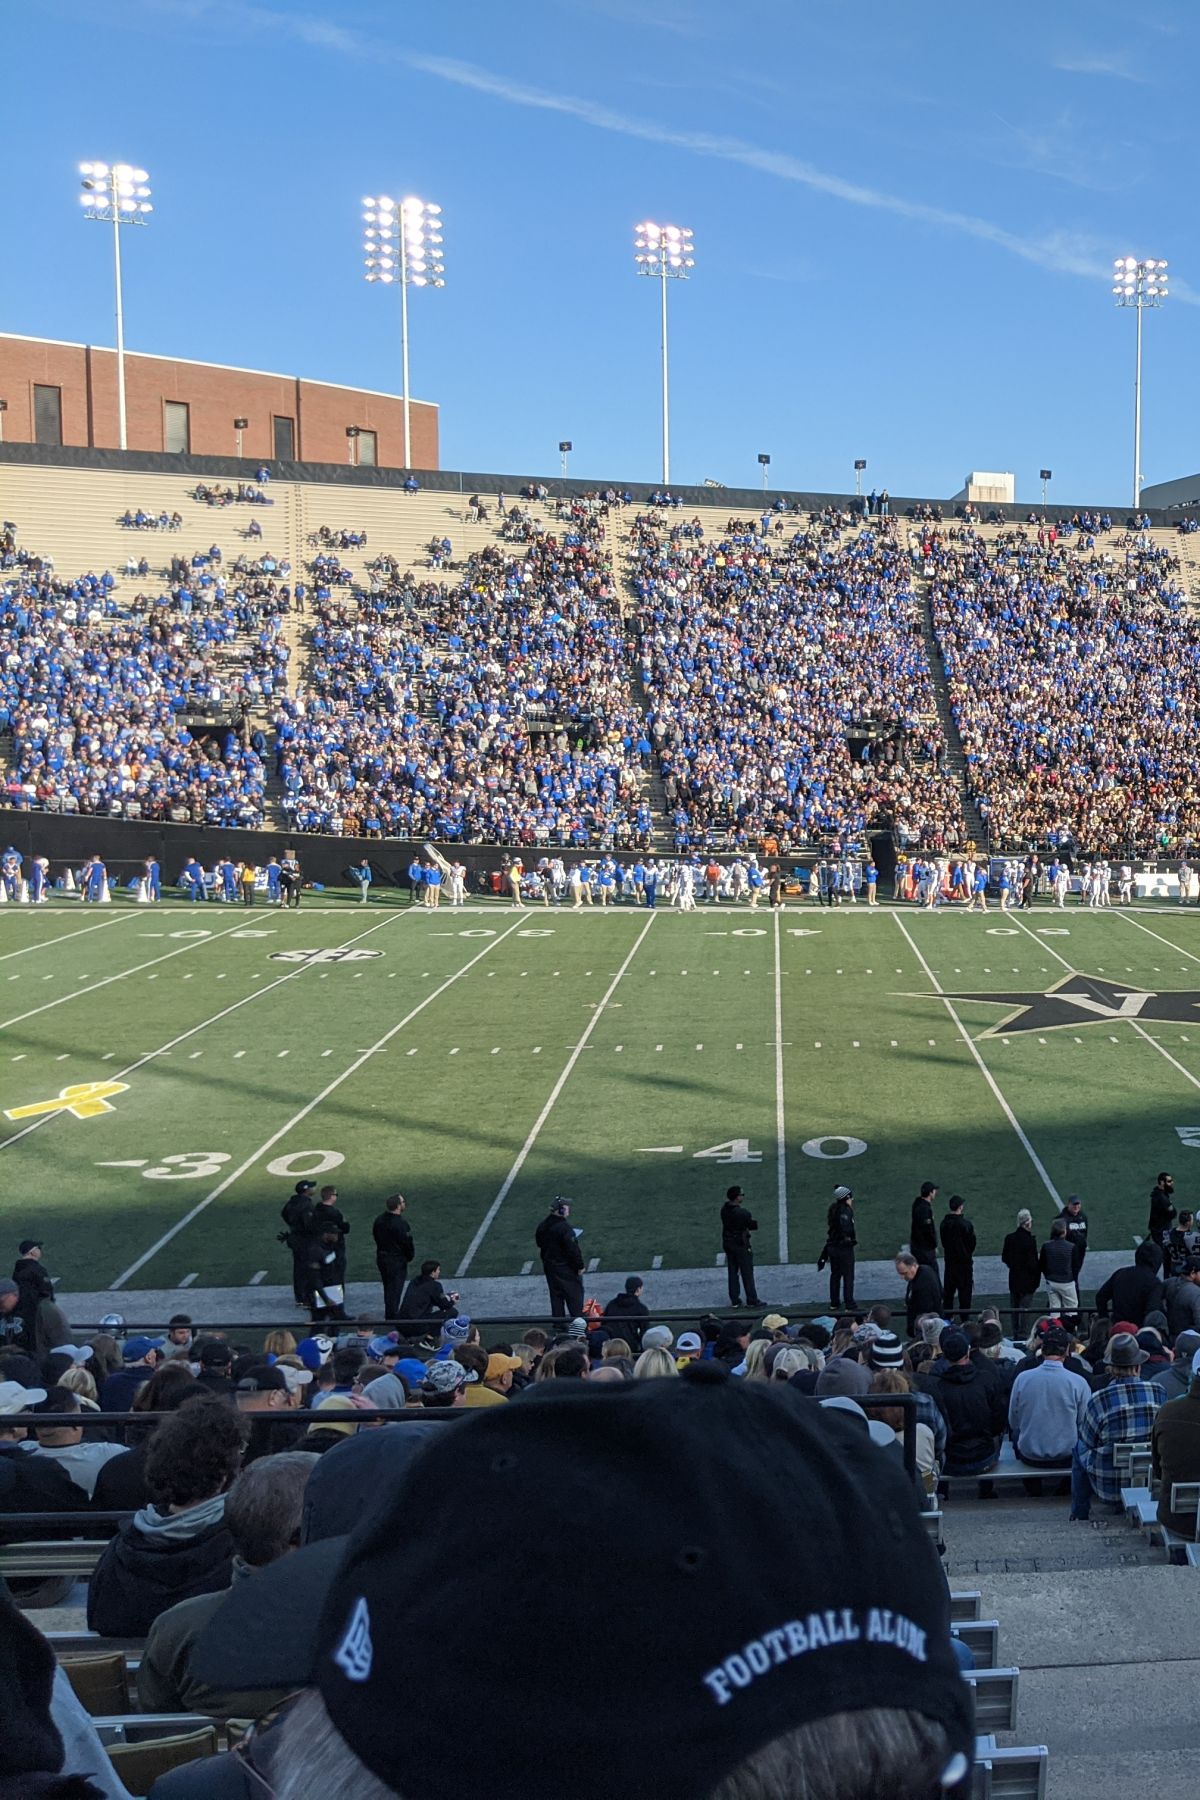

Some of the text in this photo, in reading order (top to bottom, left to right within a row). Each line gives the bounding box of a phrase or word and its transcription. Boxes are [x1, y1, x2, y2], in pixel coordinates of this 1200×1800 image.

[268, 949, 385, 962] SEC
[1044, 993, 1158, 1017] V
[692, 1136, 867, 1163] 40
[142, 1150, 345, 1179] 30
[703, 1608, 861, 1705] FOOTBALL
